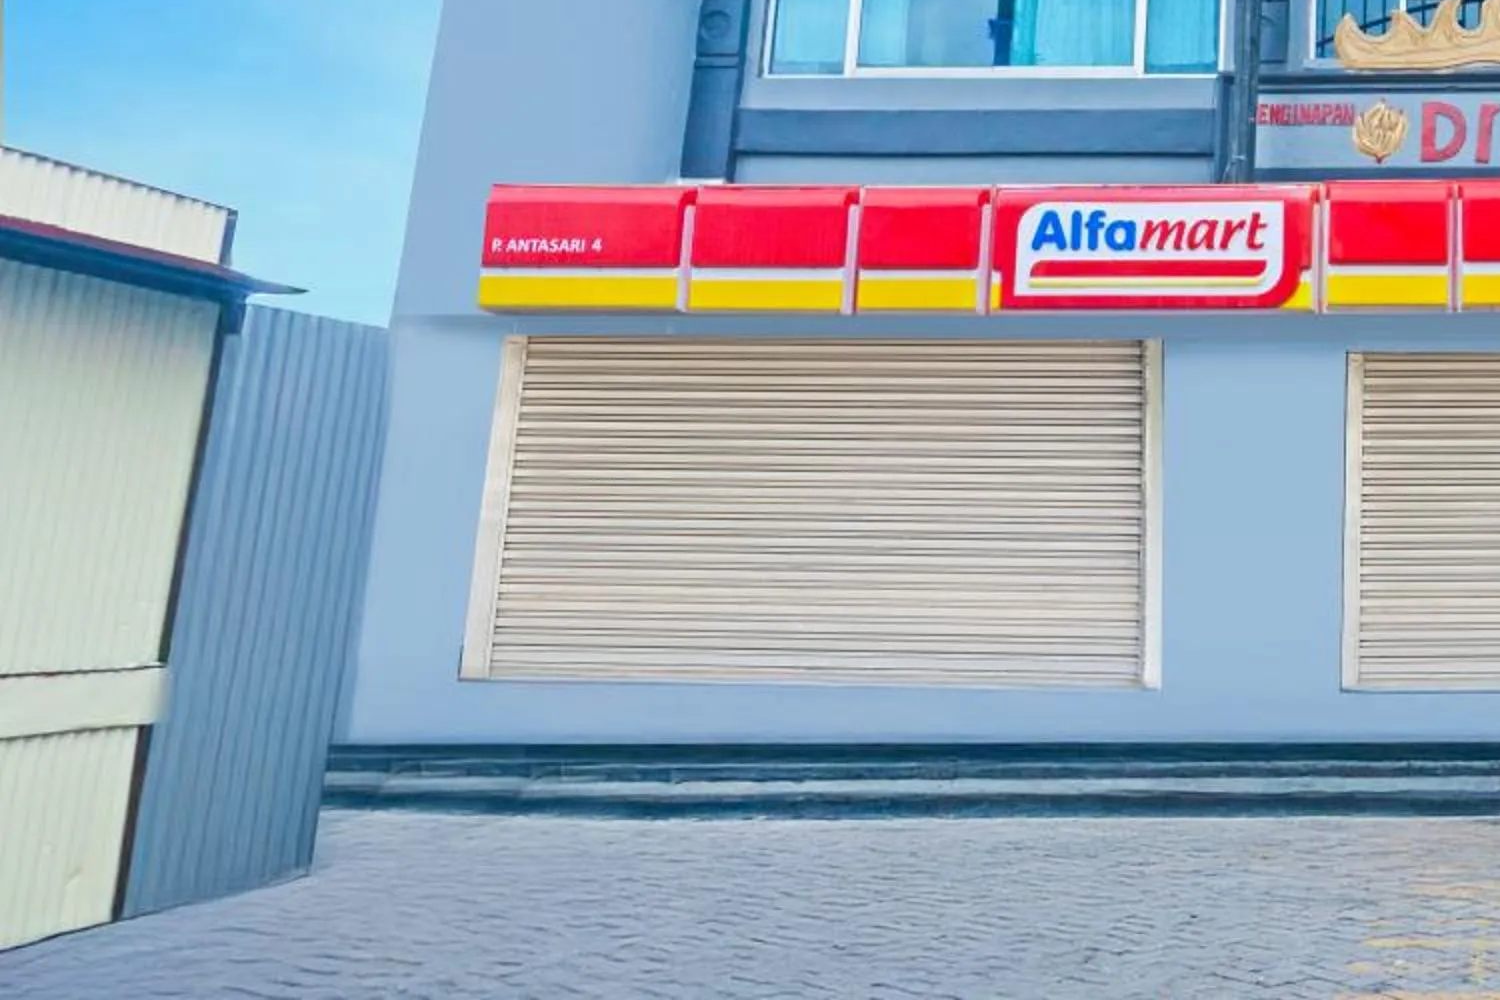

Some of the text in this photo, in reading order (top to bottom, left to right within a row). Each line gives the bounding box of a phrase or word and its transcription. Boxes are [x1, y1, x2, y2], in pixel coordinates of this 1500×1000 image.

[1031, 209, 1268, 251] Alfamart
[506, 238, 585, 253] ANTASARI
[592, 238, 602, 252] 4
